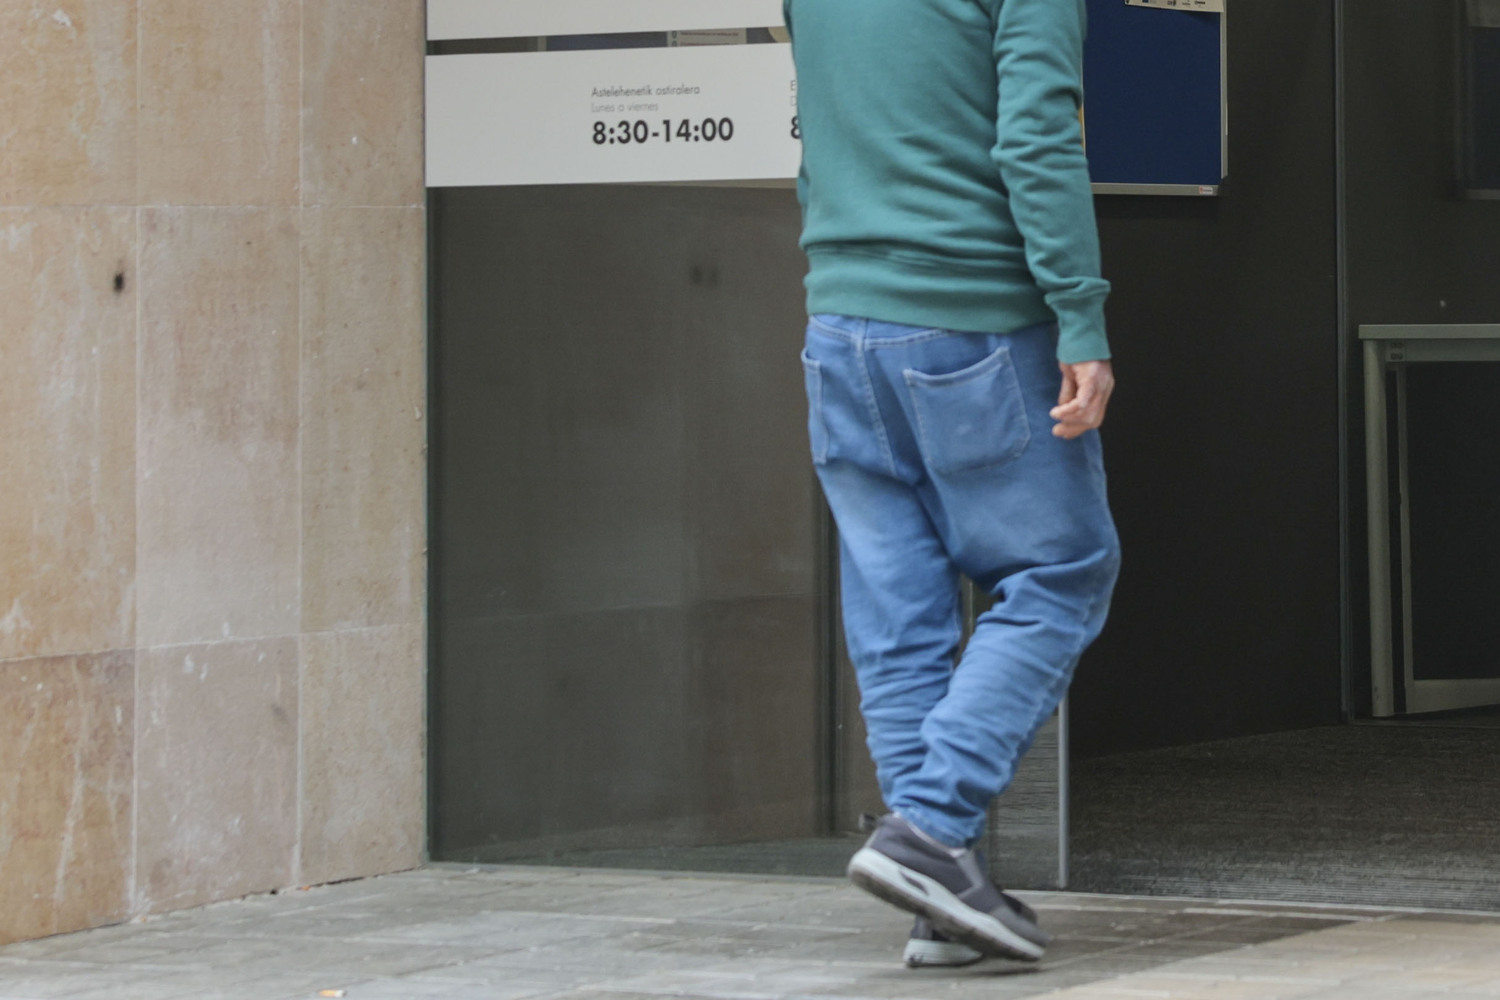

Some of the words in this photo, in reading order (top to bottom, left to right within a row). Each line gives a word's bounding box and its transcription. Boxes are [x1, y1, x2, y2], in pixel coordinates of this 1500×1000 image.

[591, 85, 653, 97] Astelehenetik
[655, 83, 701, 96] ostiralera
[591, 102, 616, 113] Lunes
[617, 104, 625, 112] a
[627, 102, 659, 112] viernes
[592, 116, 734, 145] 8:30-14:00
